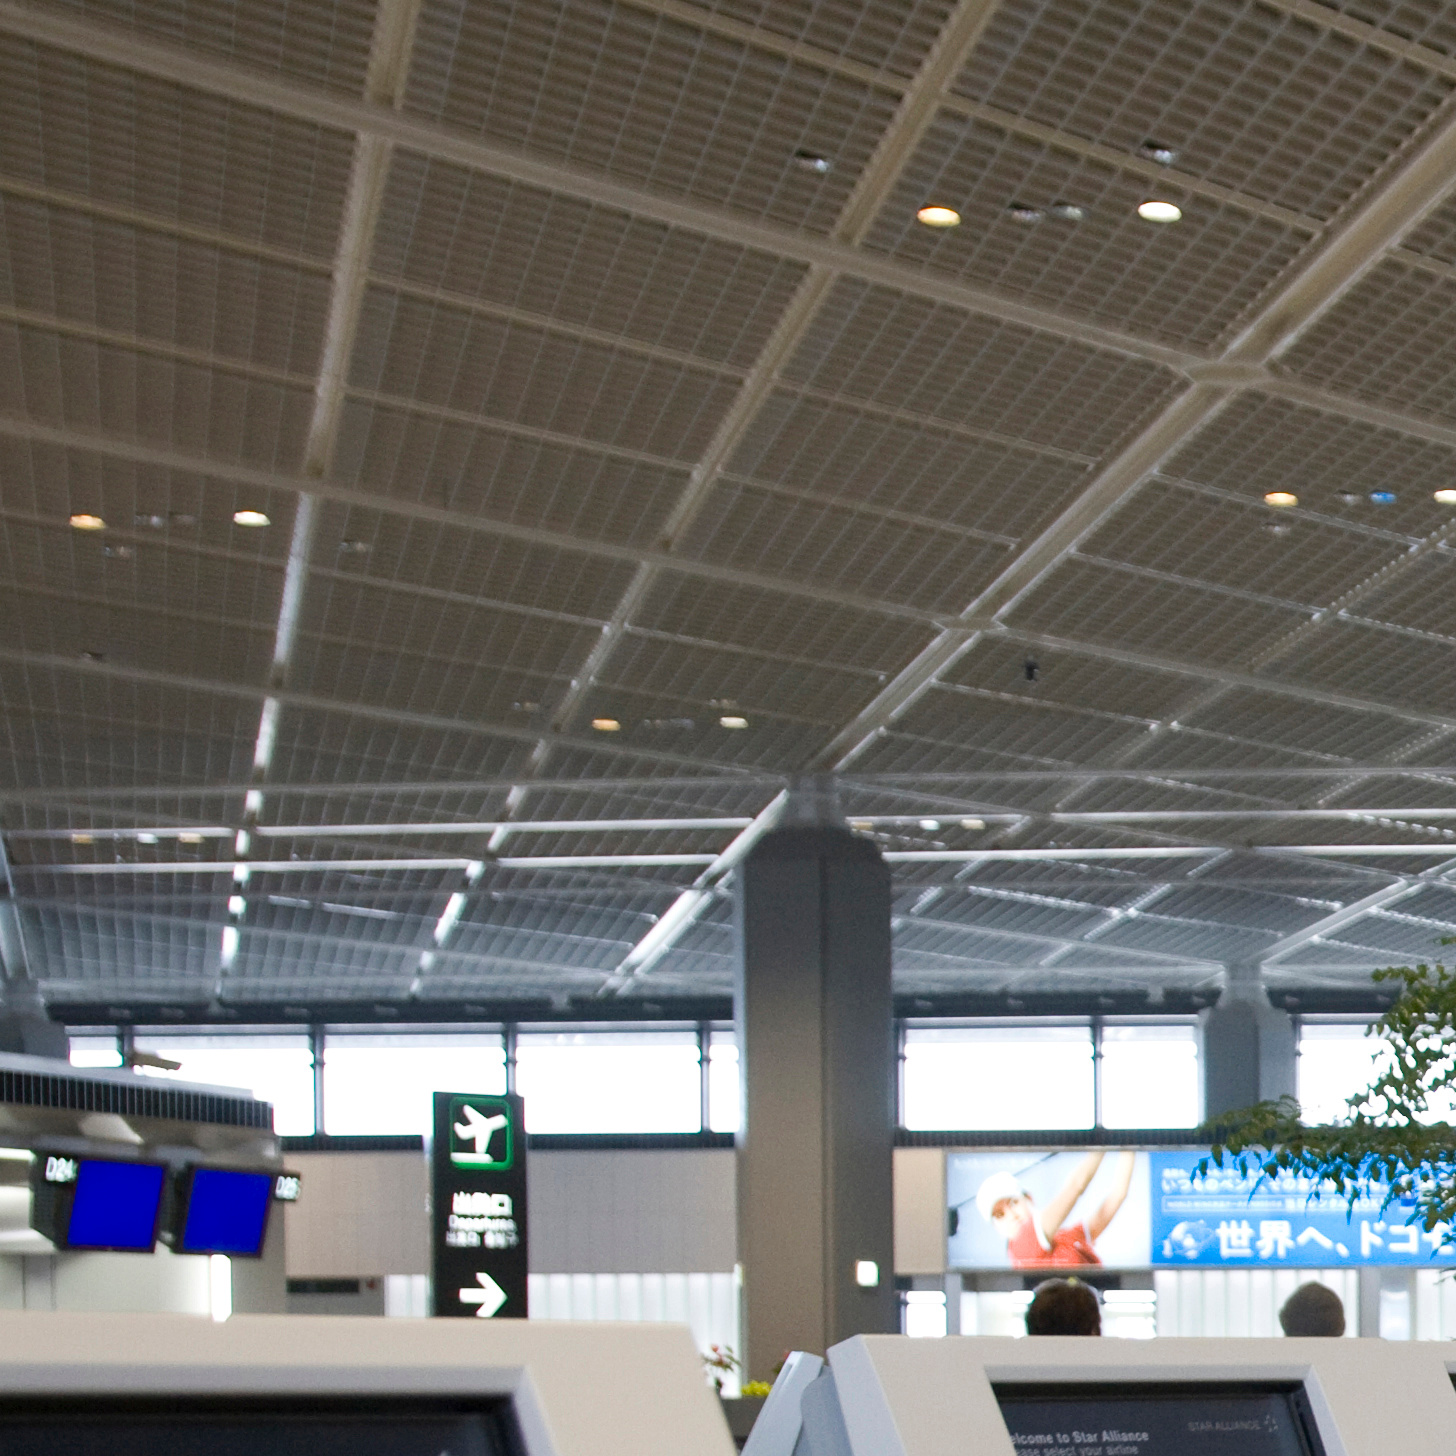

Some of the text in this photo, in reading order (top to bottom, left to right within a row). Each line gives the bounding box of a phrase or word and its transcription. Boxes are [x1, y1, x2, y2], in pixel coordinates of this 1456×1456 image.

[1010, 1430, 1149, 1445] elcome to Star Alliance
[1106, 1445, 1138, 1456] airline
